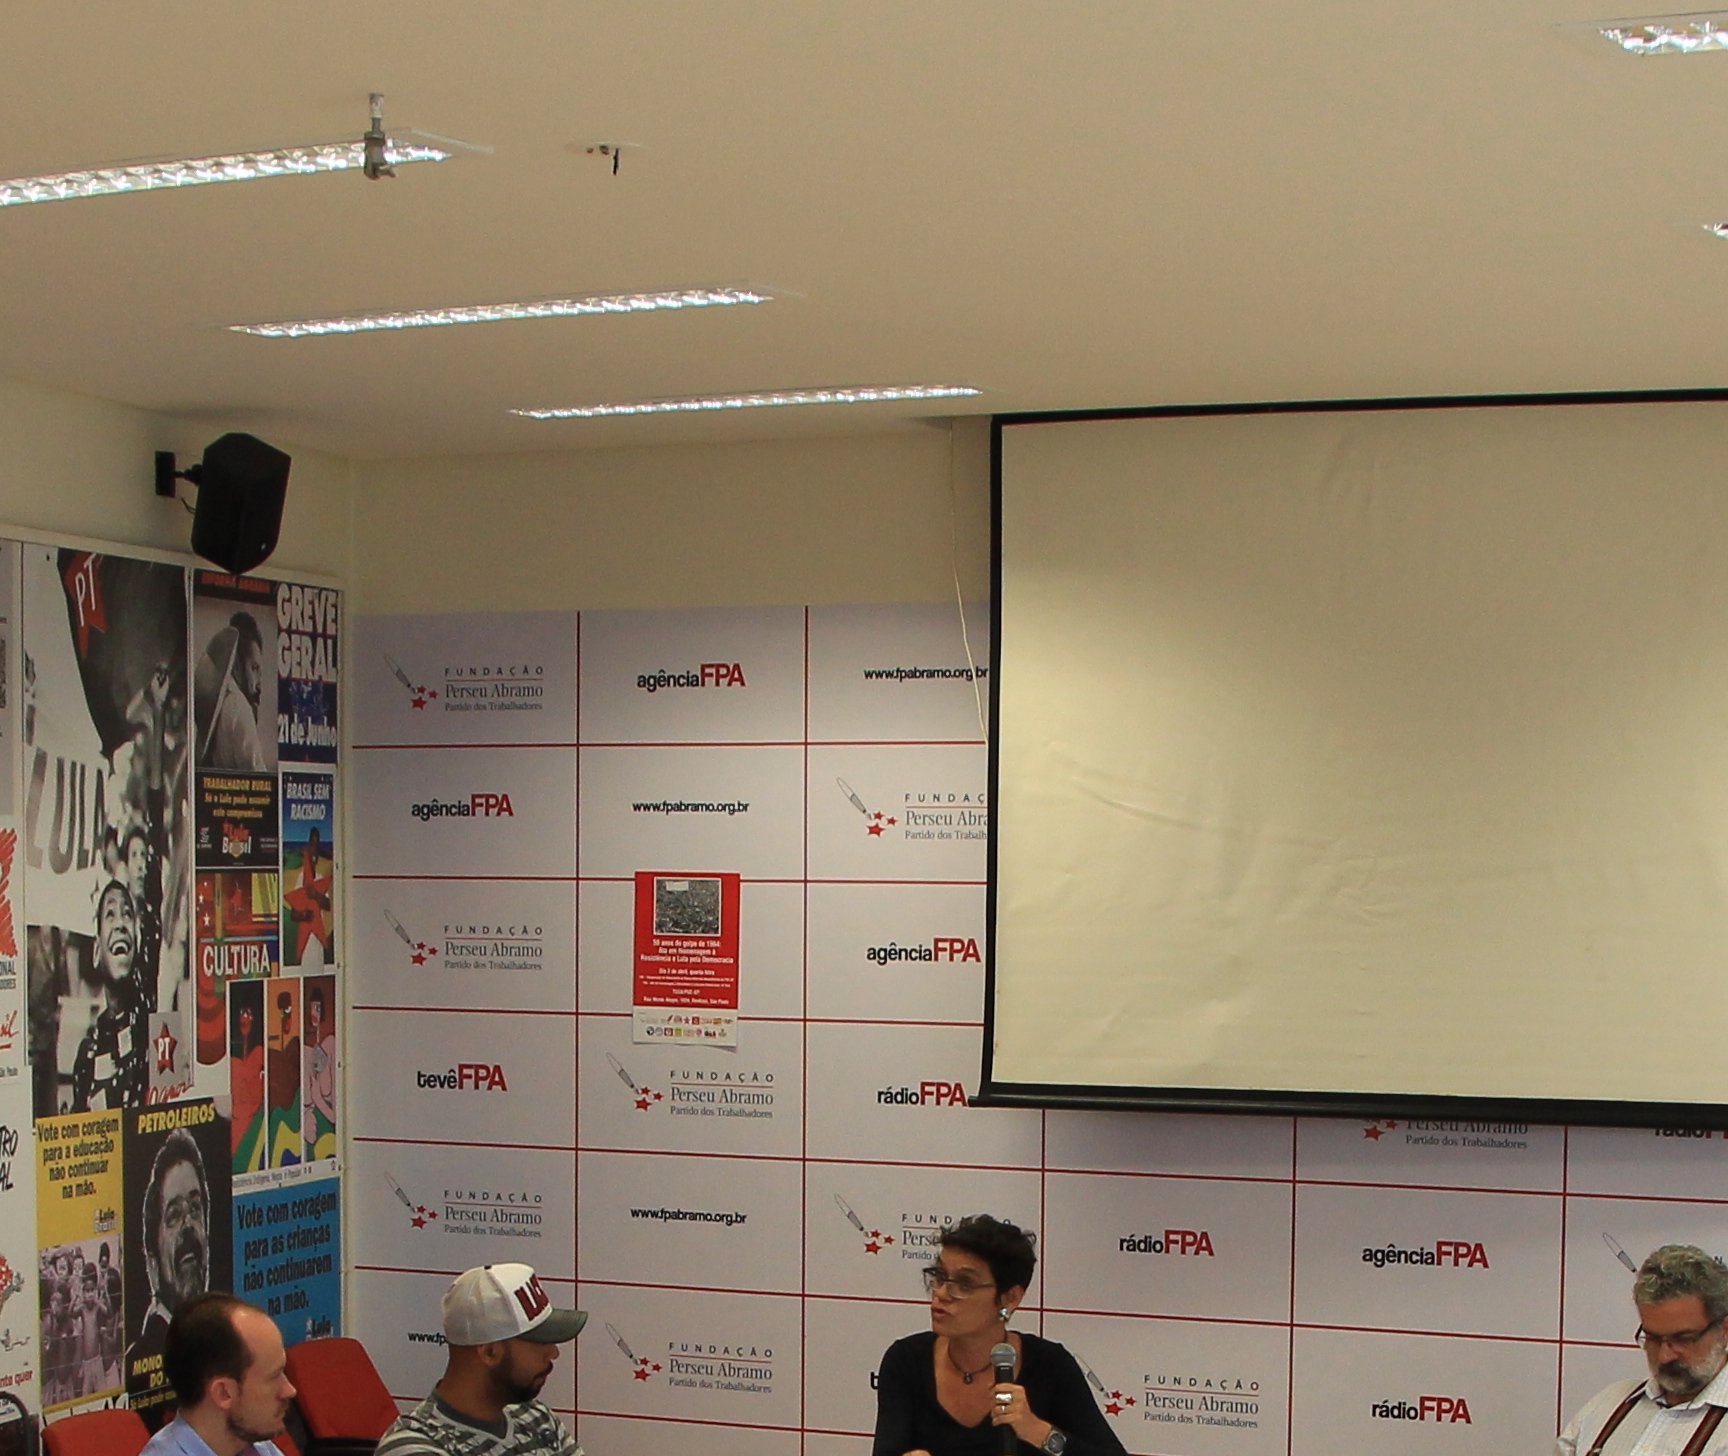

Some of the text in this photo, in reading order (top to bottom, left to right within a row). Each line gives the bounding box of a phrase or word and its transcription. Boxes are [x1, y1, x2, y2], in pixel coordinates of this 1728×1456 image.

[277, 582, 337, 635] GREVE
[277, 629, 338, 682] GERAL
[637, 663, 746, 690] agênciaFPA
[286, 782, 330, 800] BRASIL SEM
[290, 803, 326, 820] RACISMO
[632, 799, 750, 815] www.fpabramo.org.br
[203, 943, 271, 977] CULTURA
[866, 937, 981, 967] agênciaFPA
[417, 1064, 507, 1092] tevêFPA
[877, 1081, 968, 1108] rádioFPA
[38, 1117, 119, 1143] Vote com coragem
[137, 1104, 215, 1134] PETROLEIROS
[238, 1192, 336, 1230] Vote com coragem
[1119, 1230, 1214, 1257] rádioFPA
